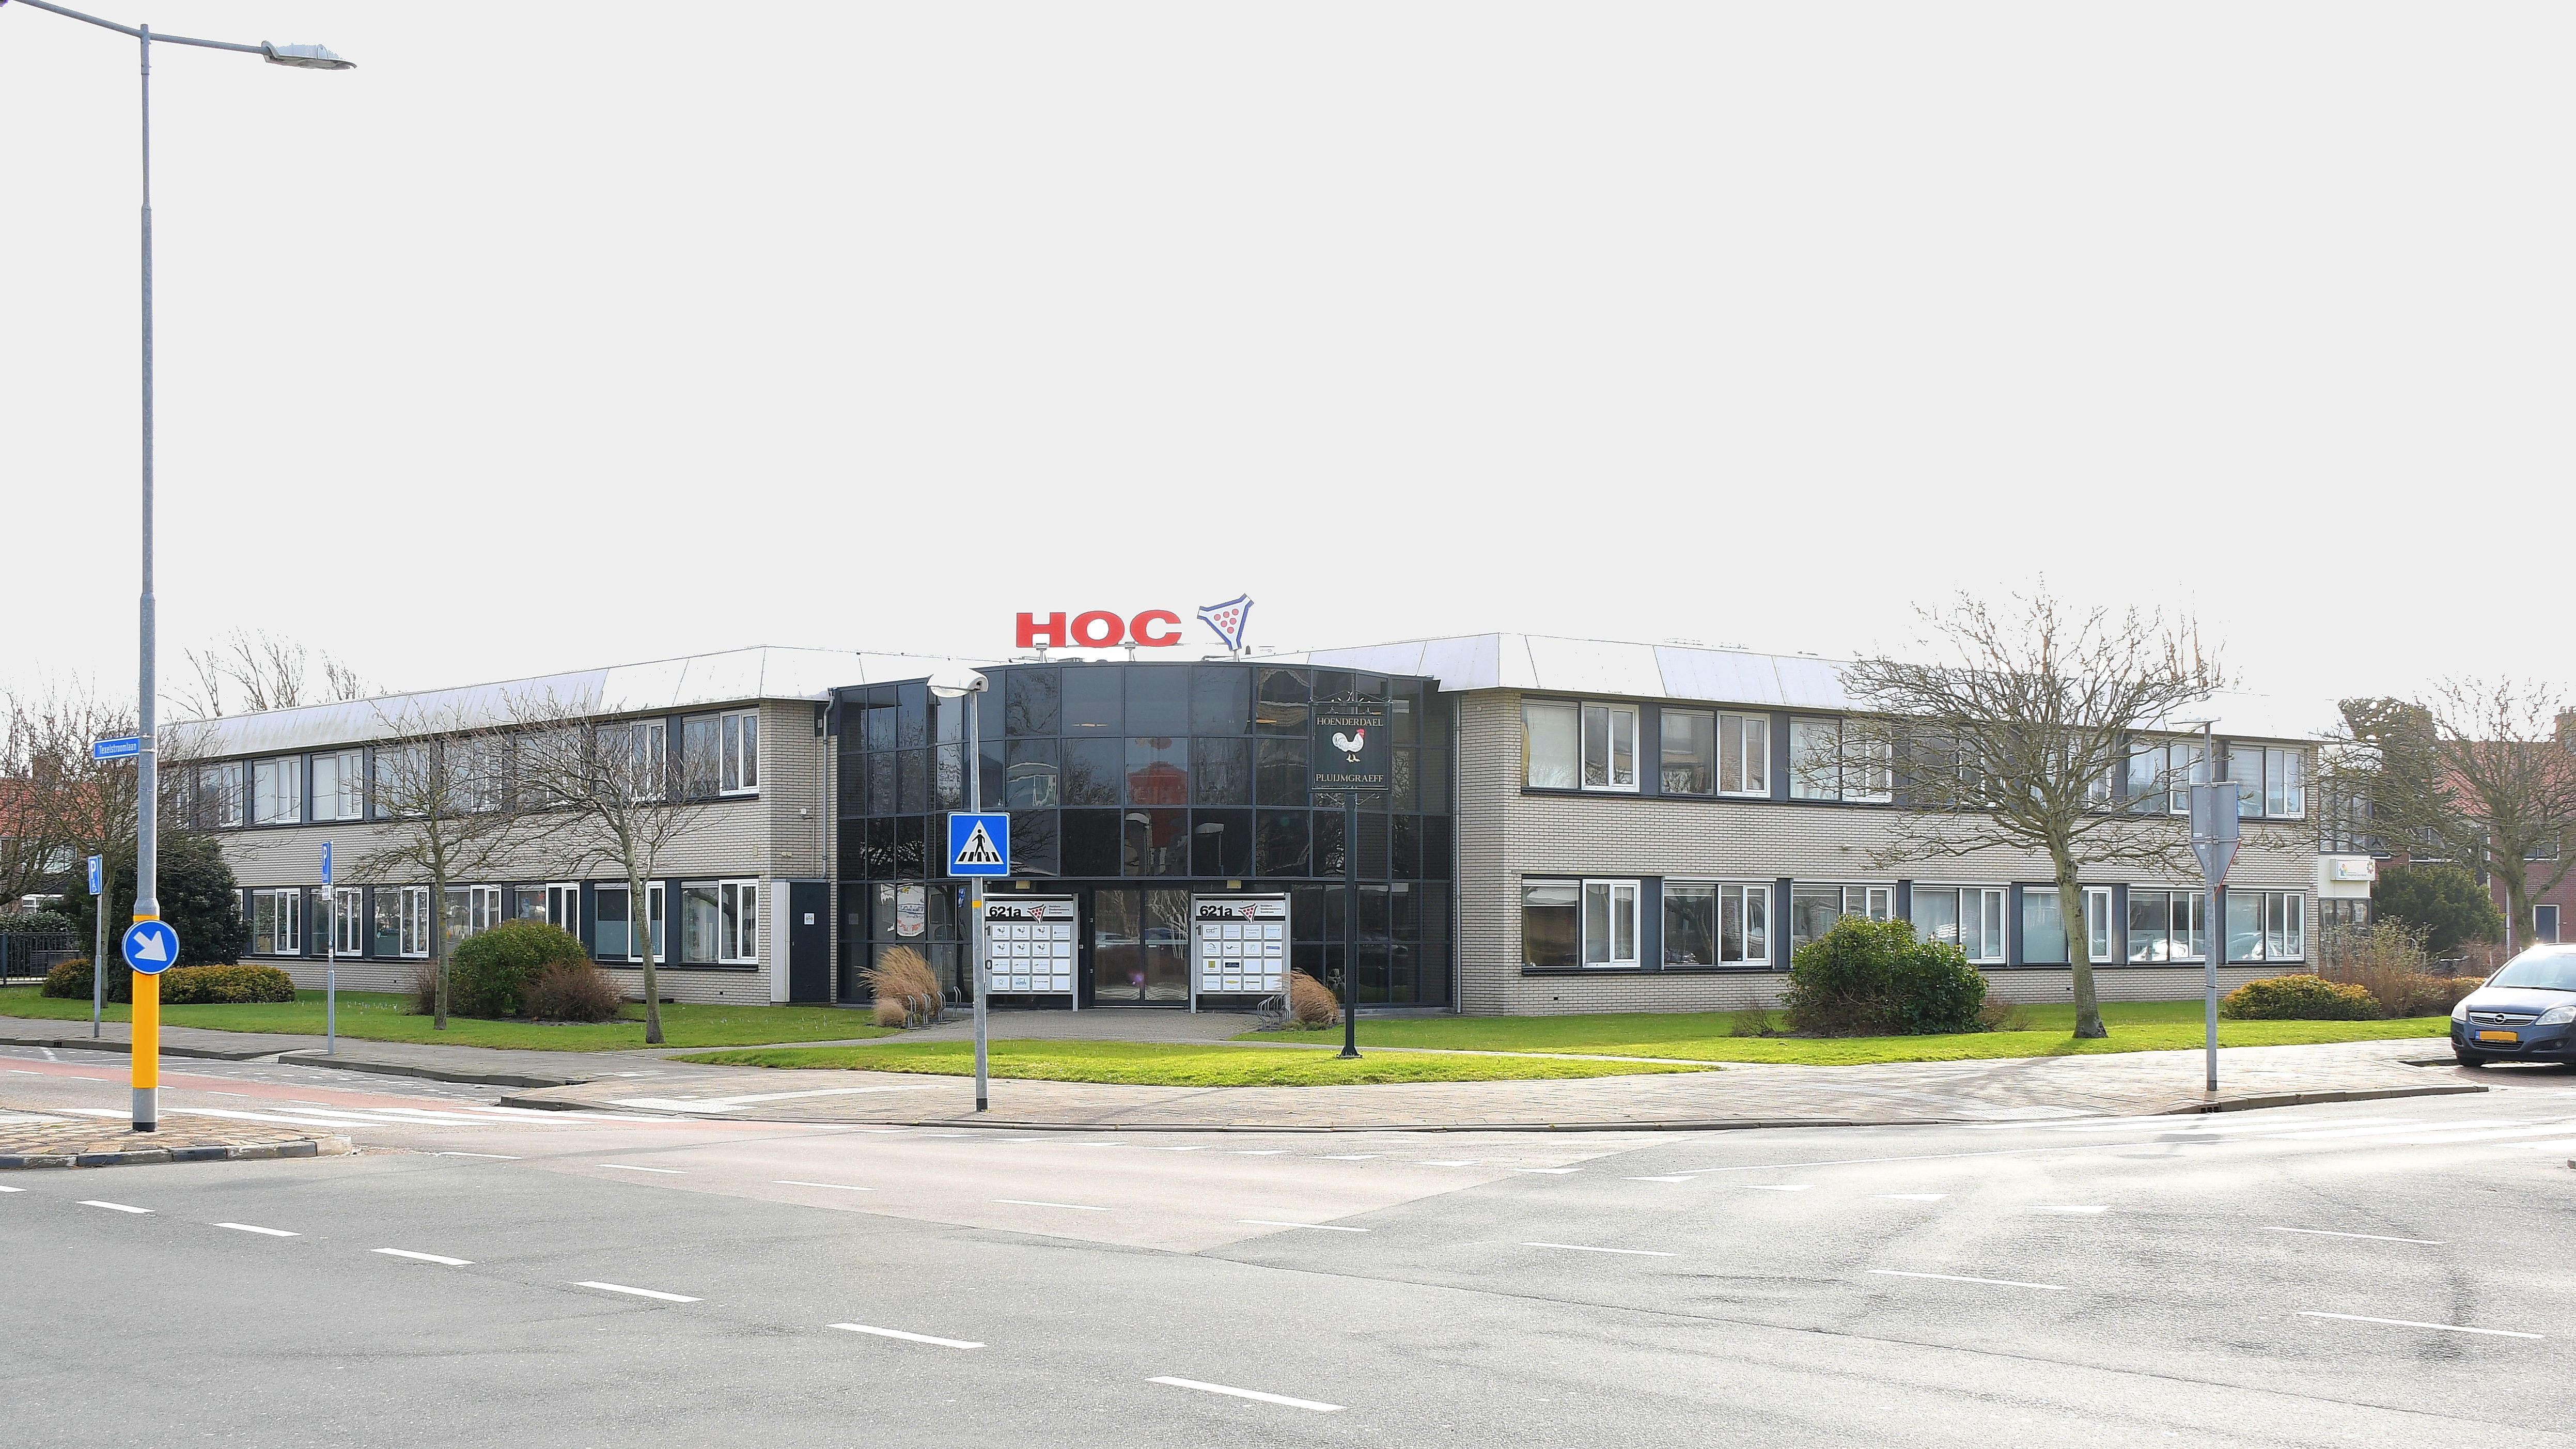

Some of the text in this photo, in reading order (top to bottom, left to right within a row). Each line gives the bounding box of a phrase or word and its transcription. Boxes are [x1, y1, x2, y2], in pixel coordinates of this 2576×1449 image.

[1016, 610, 1182, 648] HOC
[1317, 717, 1384, 726] HOENDERDAEL
[99, 742, 137, 754] Texelstroomlaan
[1316, 773, 1384, 783] PLUIJMGRAEFF
[323, 846, 327, 866] P
[90, 860, 97, 879] P
[989, 906, 1021, 917] 621a
[1199, 906, 1232, 917] 621a
[986, 925, 991, 936] 1
[1196, 925, 1201, 936] 1
